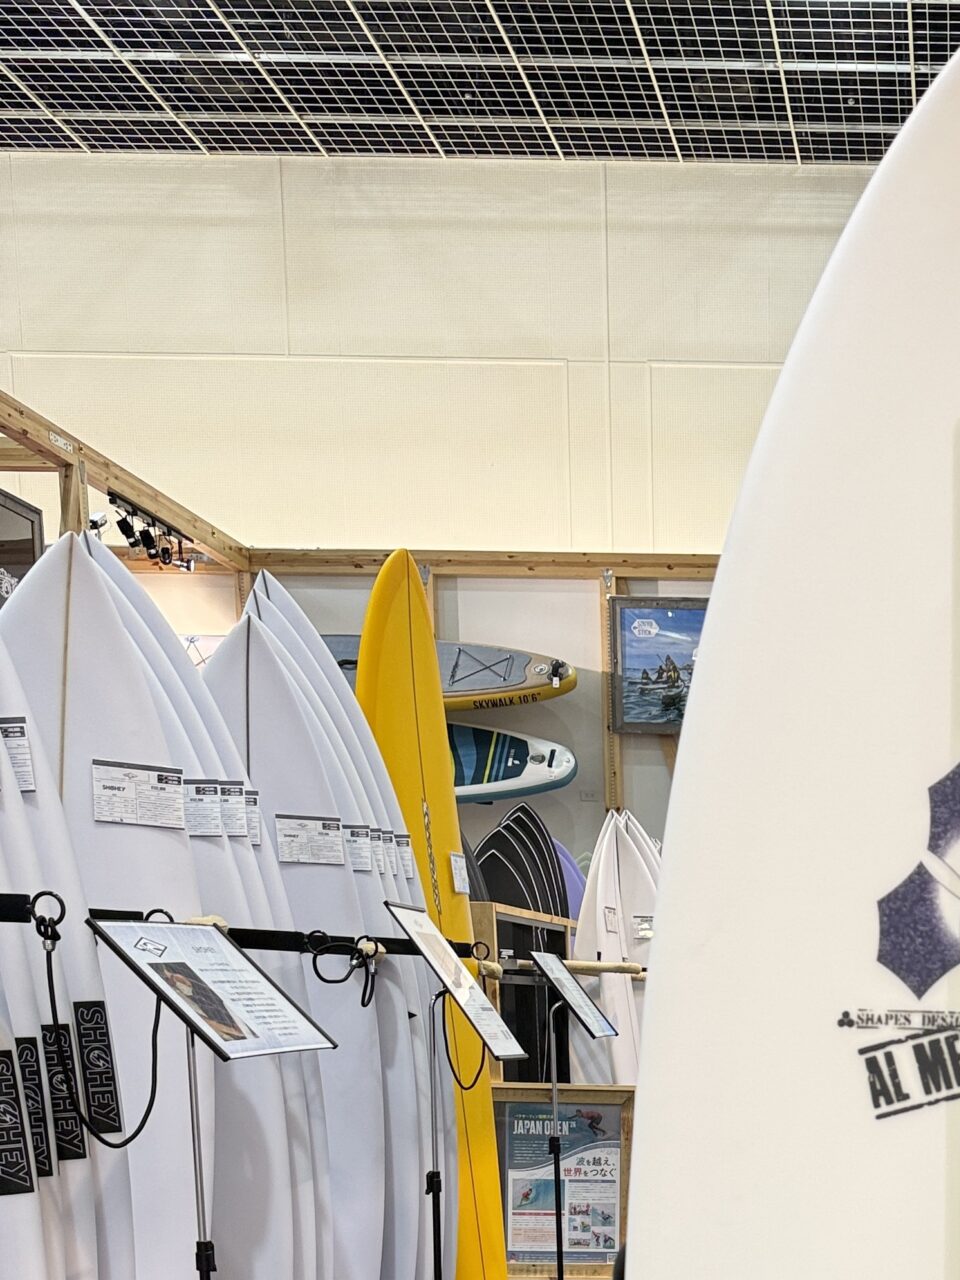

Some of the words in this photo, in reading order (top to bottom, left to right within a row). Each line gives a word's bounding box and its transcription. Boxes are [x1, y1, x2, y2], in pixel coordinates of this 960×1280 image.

[472, 696, 515, 710] SKYWALK
[856, 1013, 912, 1027] SHAPES
[78, 1006, 120, 1127] SHOHEY
[865, 1051, 911, 1109] AL
[512, 1119, 543, 1135] JAPAN
[575, 1156, 617, 1167] 波を越え、
[563, 1167, 617, 1178] 世界をつなぐ
